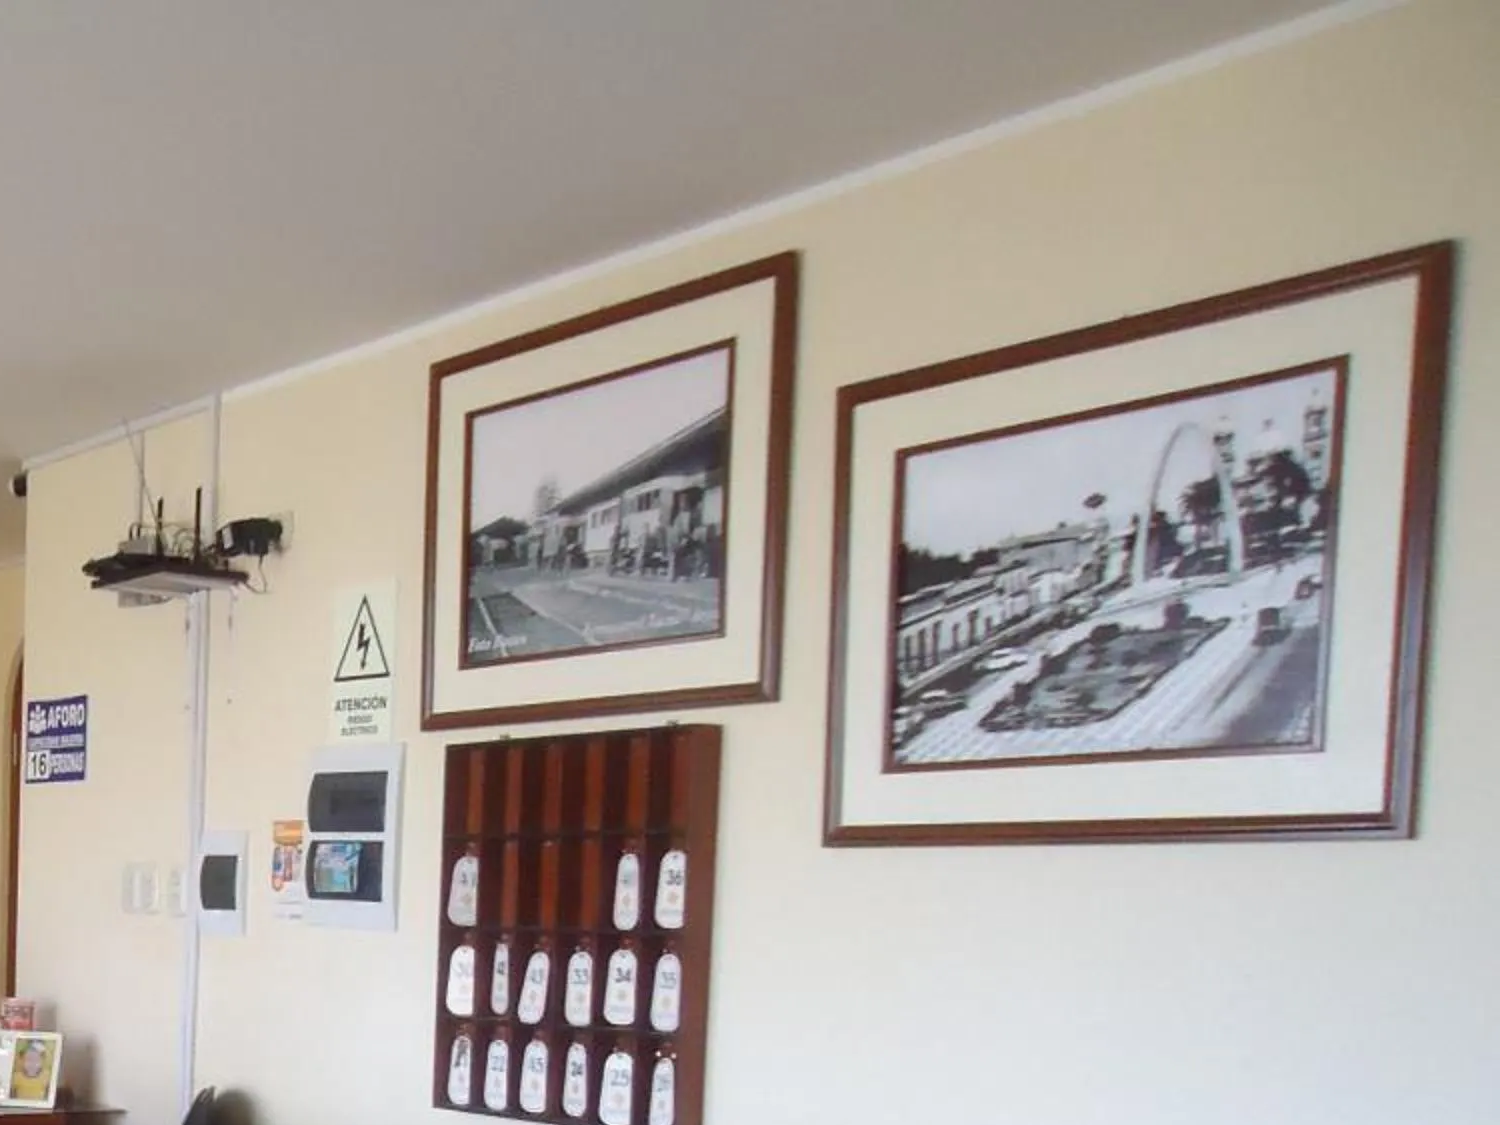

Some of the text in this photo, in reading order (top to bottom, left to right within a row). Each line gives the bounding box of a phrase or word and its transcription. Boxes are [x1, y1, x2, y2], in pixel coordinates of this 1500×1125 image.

[334, 692, 388, 712] ATENCIÓN
[47, 704, 85, 728] AFORO
[31, 753, 47, 777] 16
